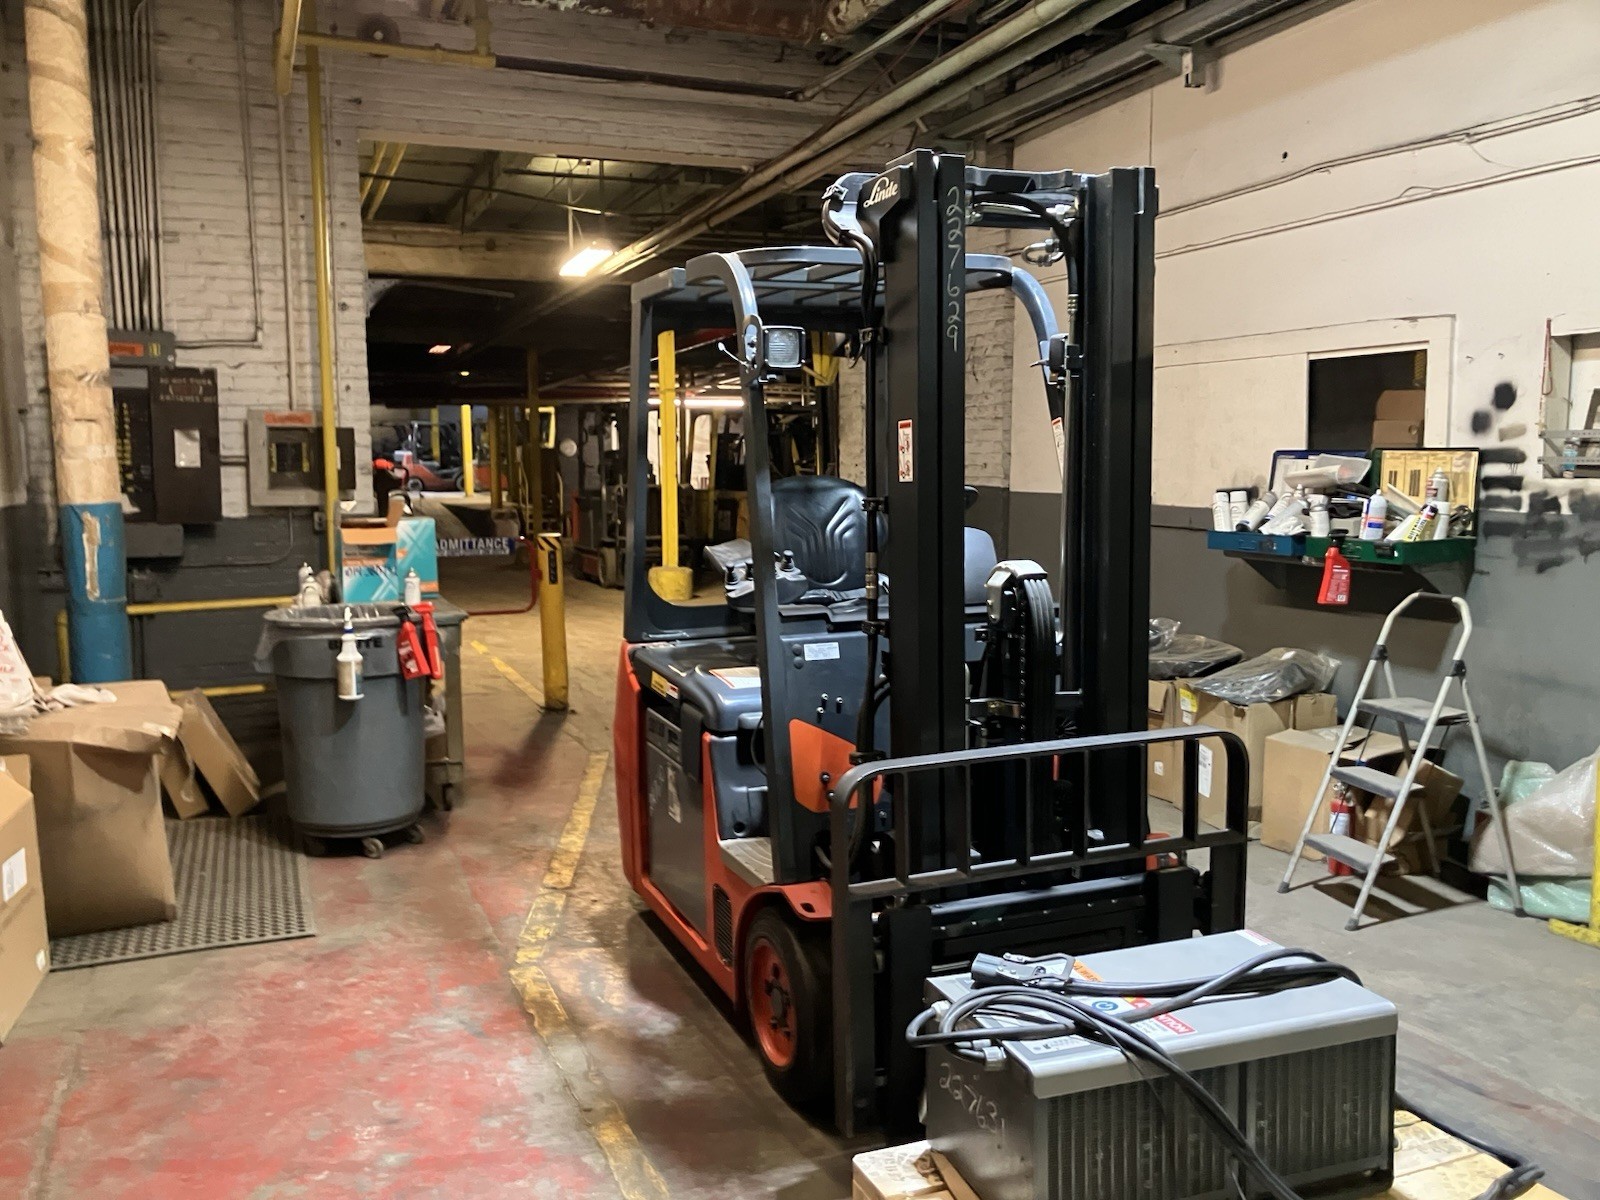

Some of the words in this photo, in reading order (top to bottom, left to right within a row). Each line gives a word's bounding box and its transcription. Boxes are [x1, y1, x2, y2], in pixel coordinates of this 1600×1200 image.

[863, 176, 899, 208] Linde
[946, 186, 963, 353] 2227629
[327, 636, 383, 651] BTE
